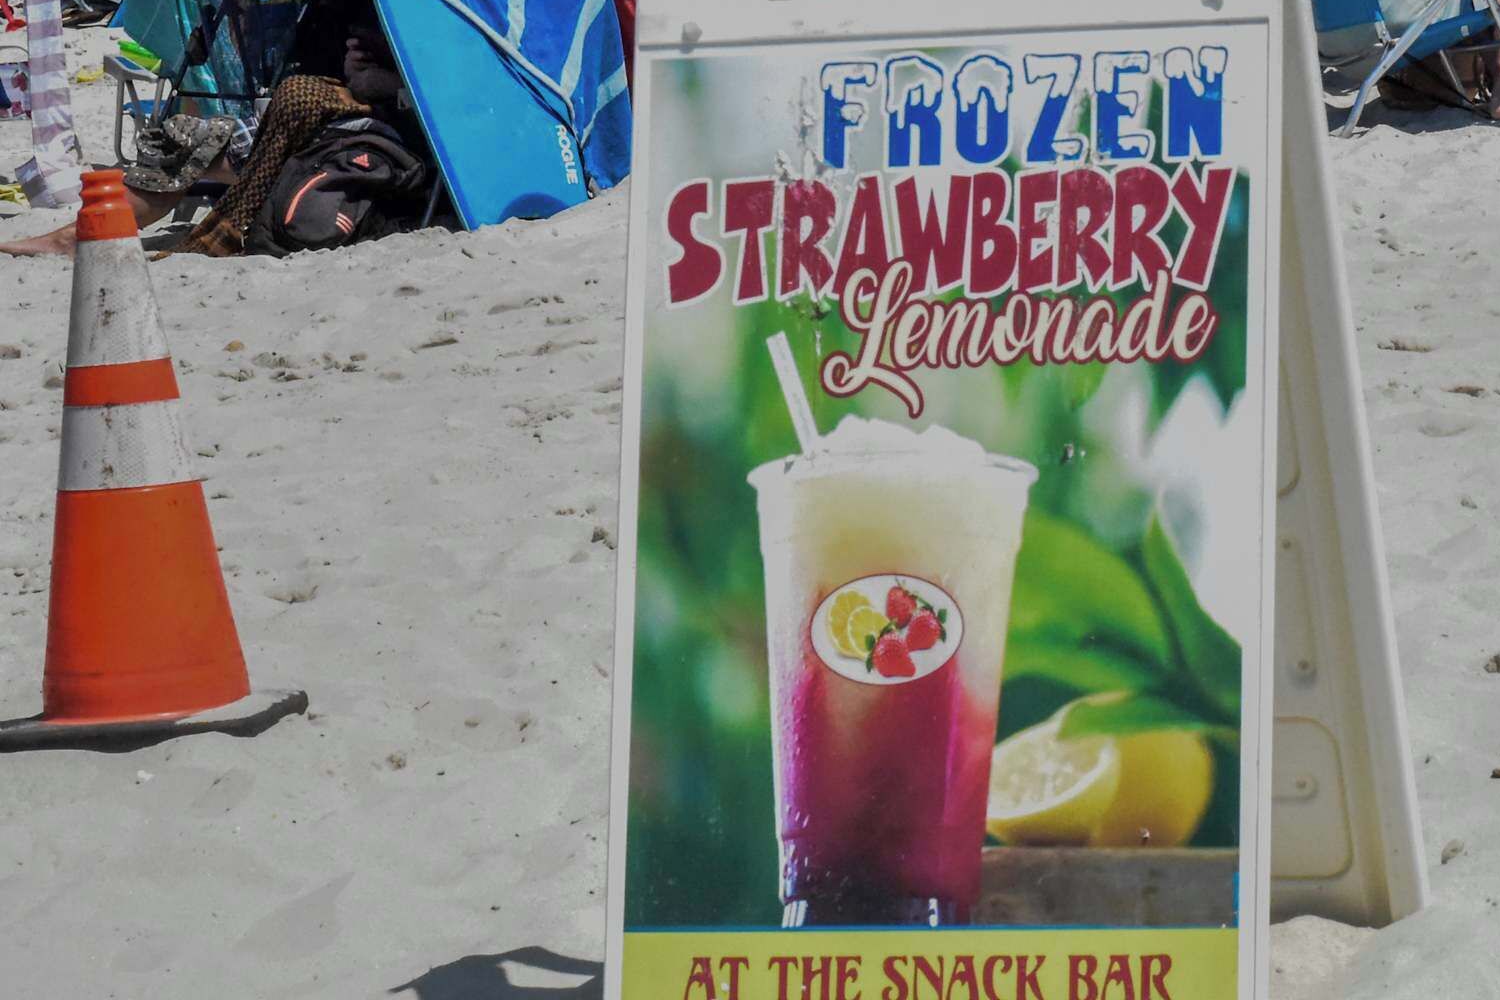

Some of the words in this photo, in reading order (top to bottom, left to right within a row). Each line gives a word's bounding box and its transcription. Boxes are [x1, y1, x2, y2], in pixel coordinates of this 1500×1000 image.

[555, 124, 579, 185] ROGUE
[820, 46, 1228, 169] FROZEN
[666, 166, 1233, 303] STRAWBERRY
[820, 261, 1217, 418] Lemonade
[685, 956, 749, 1000] AT
[769, 956, 861, 1000] THE
[882, 955, 1046, 1000] SNACK
[1067, 954, 1174, 1000] BAR
